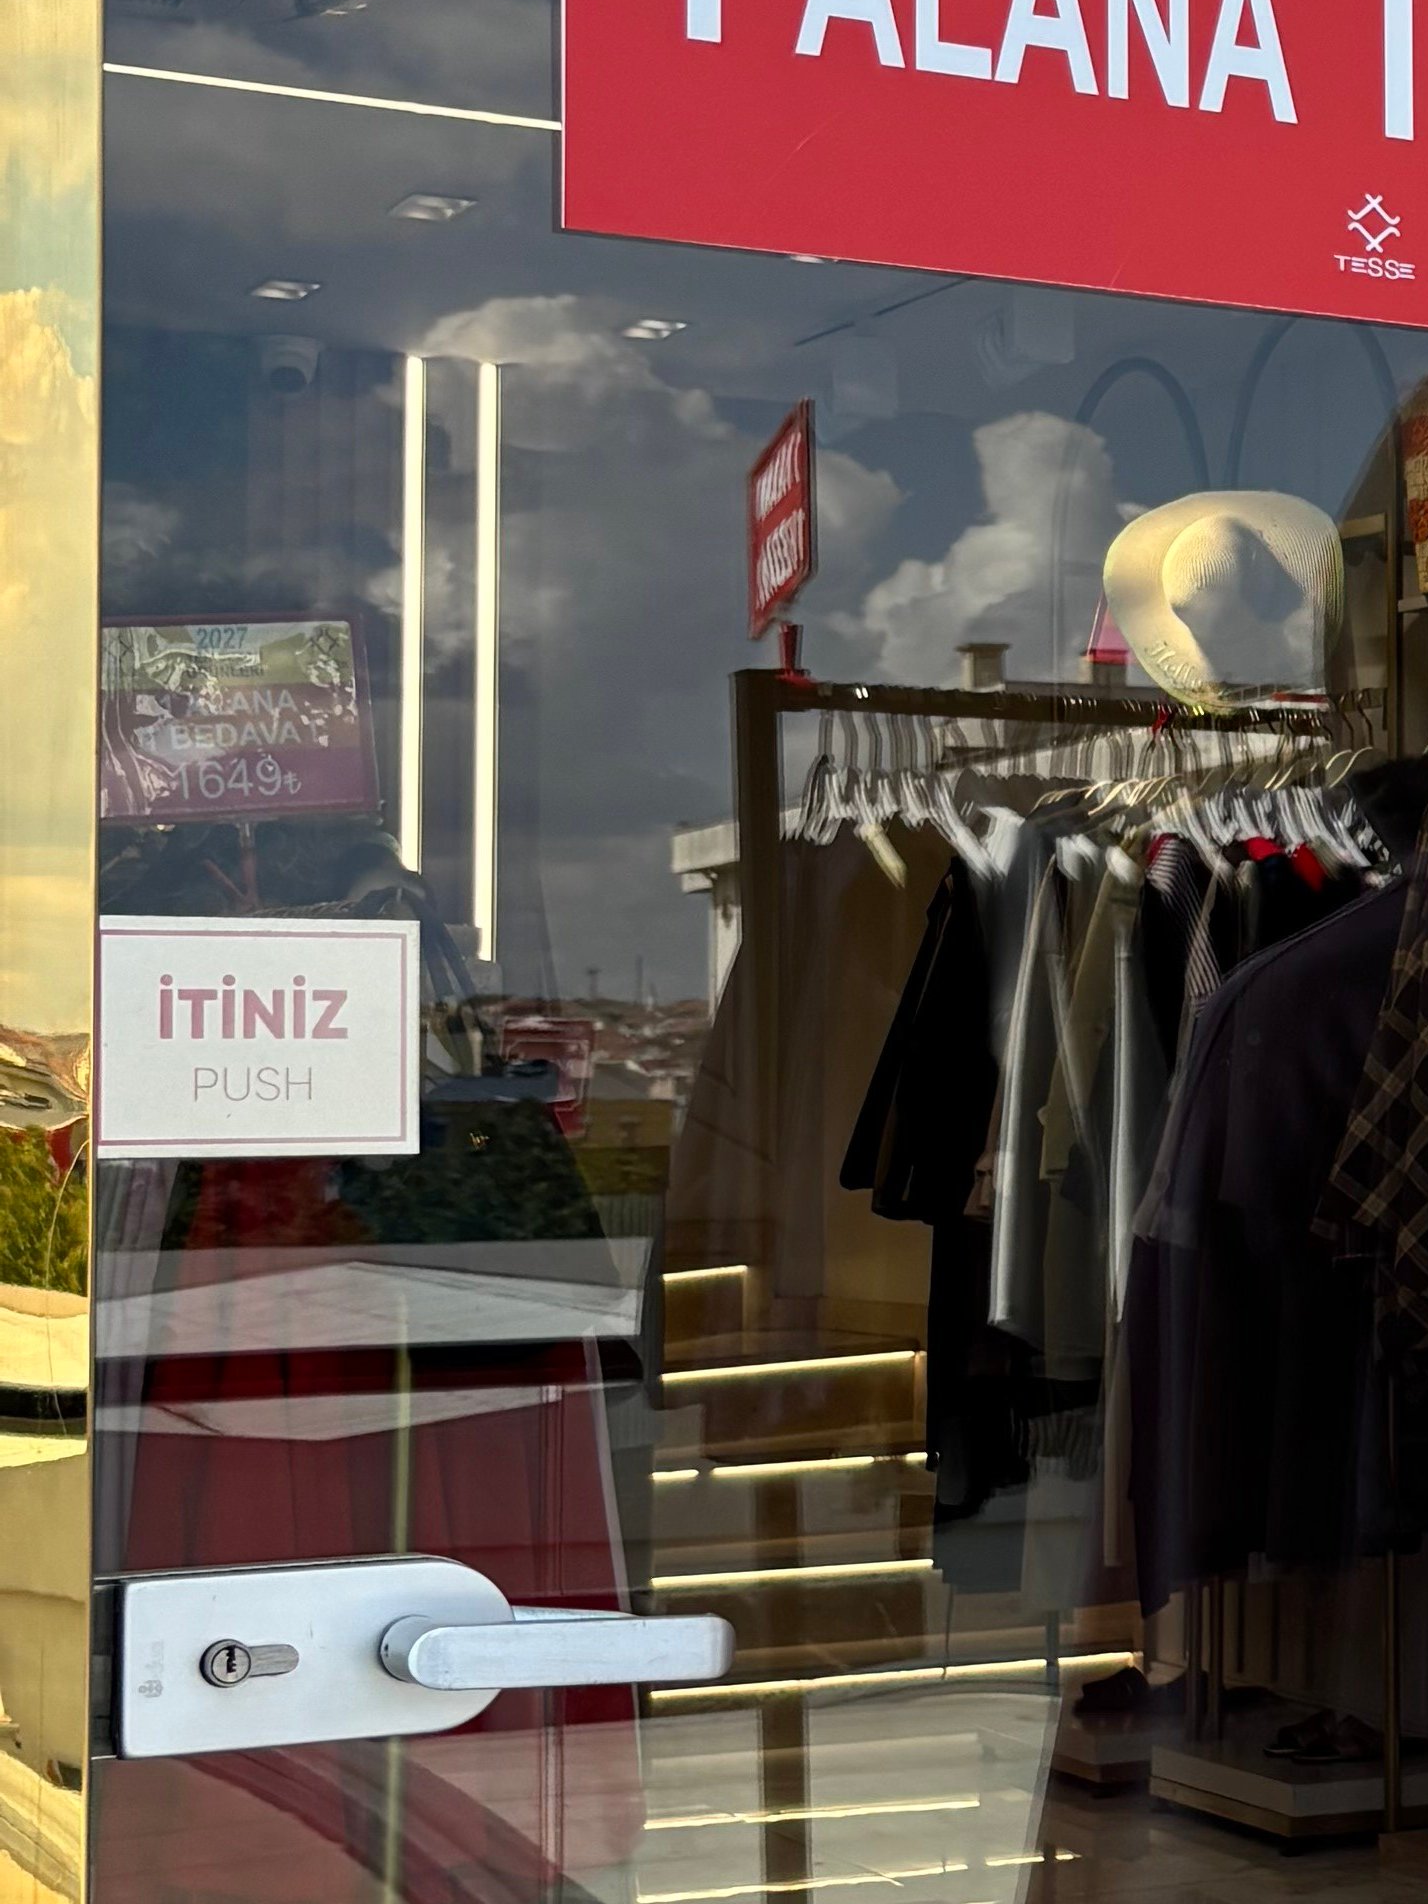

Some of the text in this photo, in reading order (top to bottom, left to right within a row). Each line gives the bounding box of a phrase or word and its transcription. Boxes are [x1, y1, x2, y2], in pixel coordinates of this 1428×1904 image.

[1333, 254, 1416, 280] TESSE
[187, 689, 299, 717] AANA
[169, 720, 302, 750] BEDAVA
[159, 973, 349, 1040] İTİNİZ
[193, 1066, 313, 1102] PUSH
